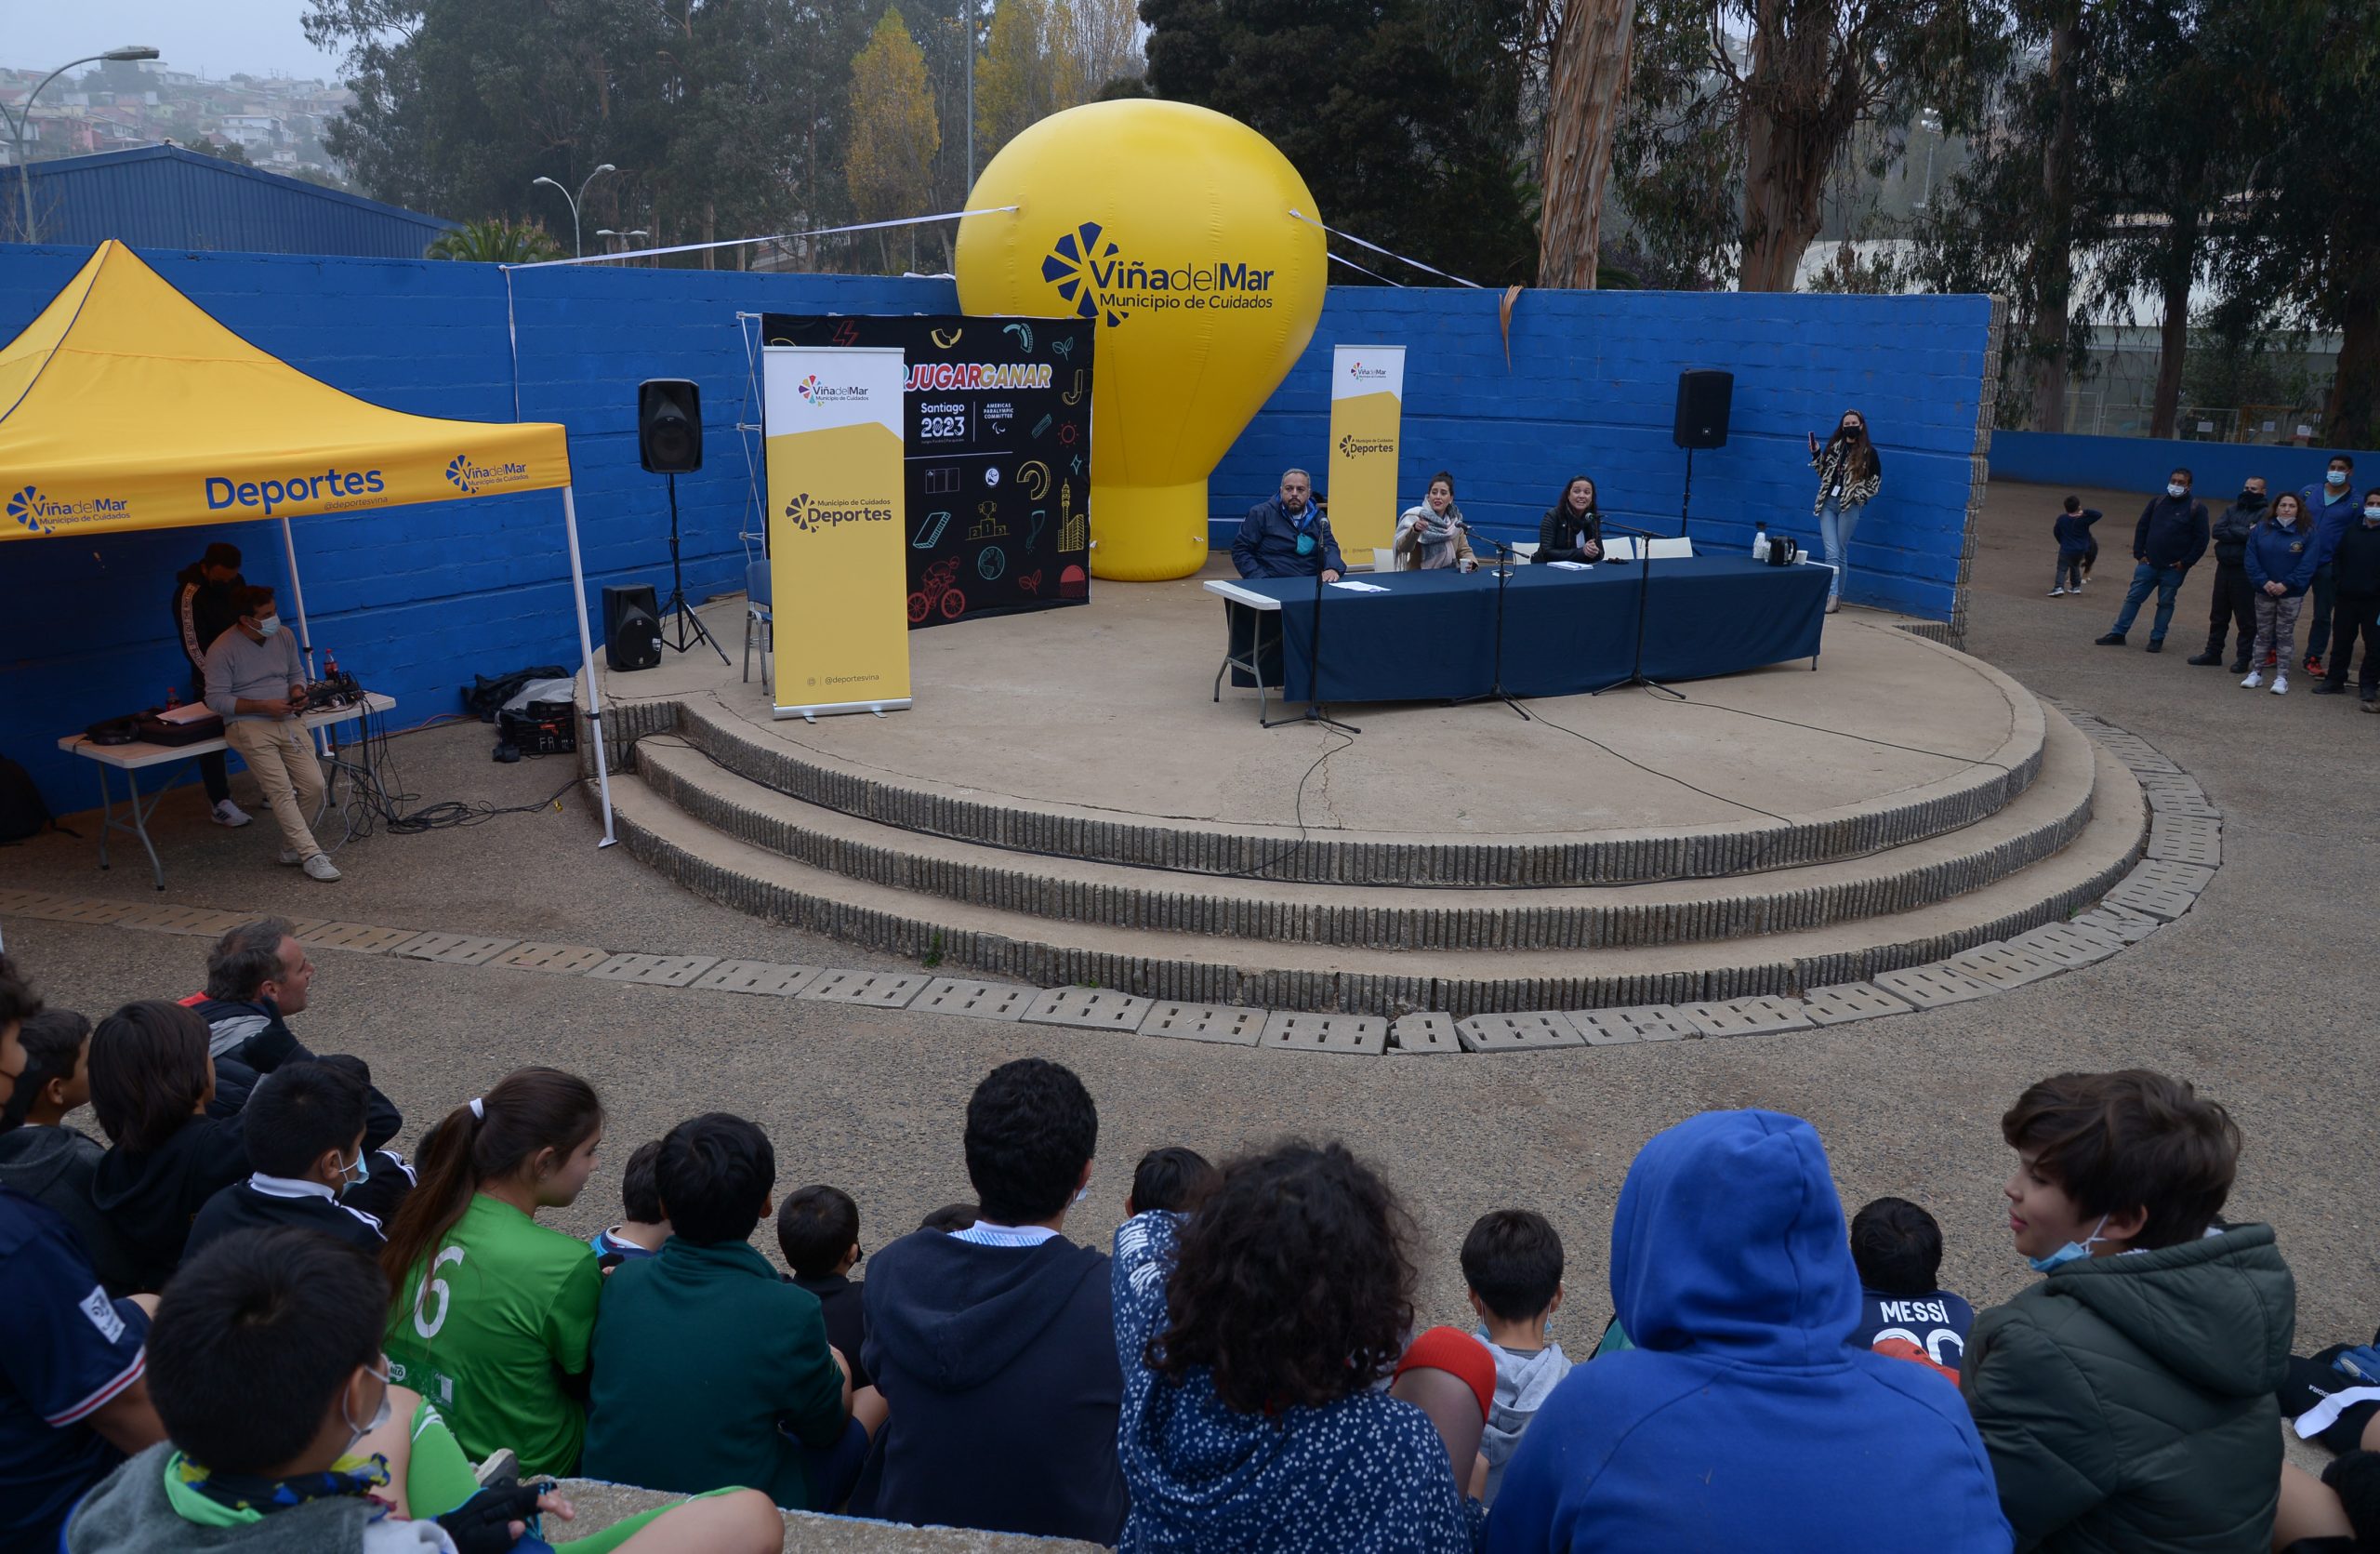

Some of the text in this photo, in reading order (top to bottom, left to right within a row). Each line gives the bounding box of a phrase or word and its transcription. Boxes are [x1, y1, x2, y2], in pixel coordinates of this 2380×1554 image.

[1089, 260, 1275, 292] ViñadelMar
[1099, 293, 1273, 312] Municipio de Cuidados
[813, 386, 868, 395] ViñadelMar
[920, 402, 965, 415] Santiago
[920, 416, 965, 438] 2023
[1350, 443, 1394, 456] Deportes
[463, 463, 526, 480] ViñadelMar
[205, 469, 385, 514] Deportes
[33, 498, 127, 516] ViñadelMar
[324, 497, 389, 511] @deportesvina
[39, 516, 80, 525] Municipio
[92, 512, 130, 521] Cuidados
[807, 508, 892, 526] Deportes
[825, 674, 879, 684] @deportesvina
[414, 1246, 465, 1339] 6
[1879, 1299, 1950, 1324] MESSI
